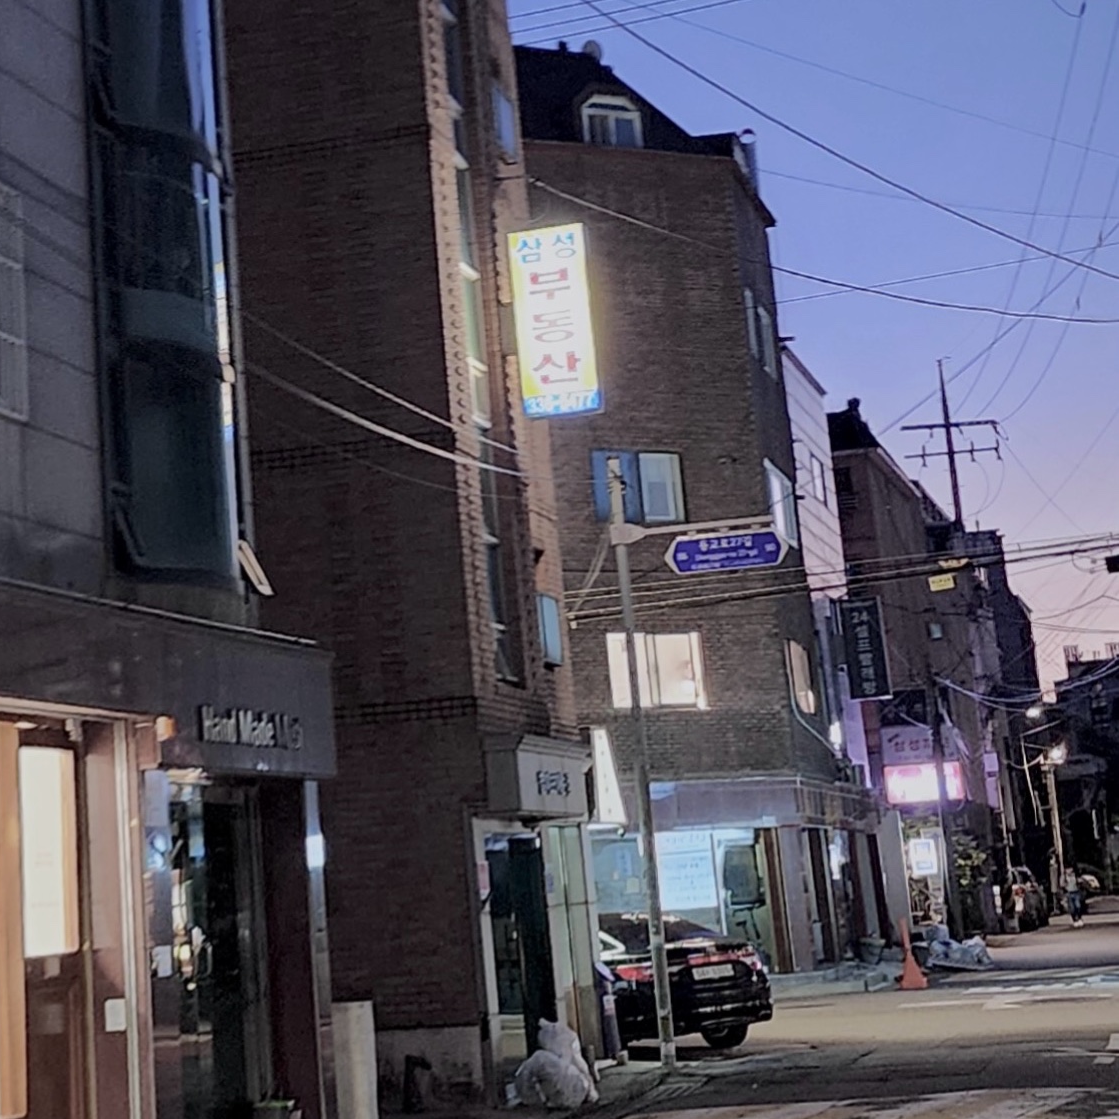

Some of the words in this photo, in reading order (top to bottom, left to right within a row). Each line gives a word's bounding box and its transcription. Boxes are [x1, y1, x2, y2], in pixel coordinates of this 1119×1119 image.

[517, 232, 576, 264] 삼성
[529, 268, 581, 384] 부동산
[201, 705, 237, 743] Hand
[238, 709, 275, 746] Made
